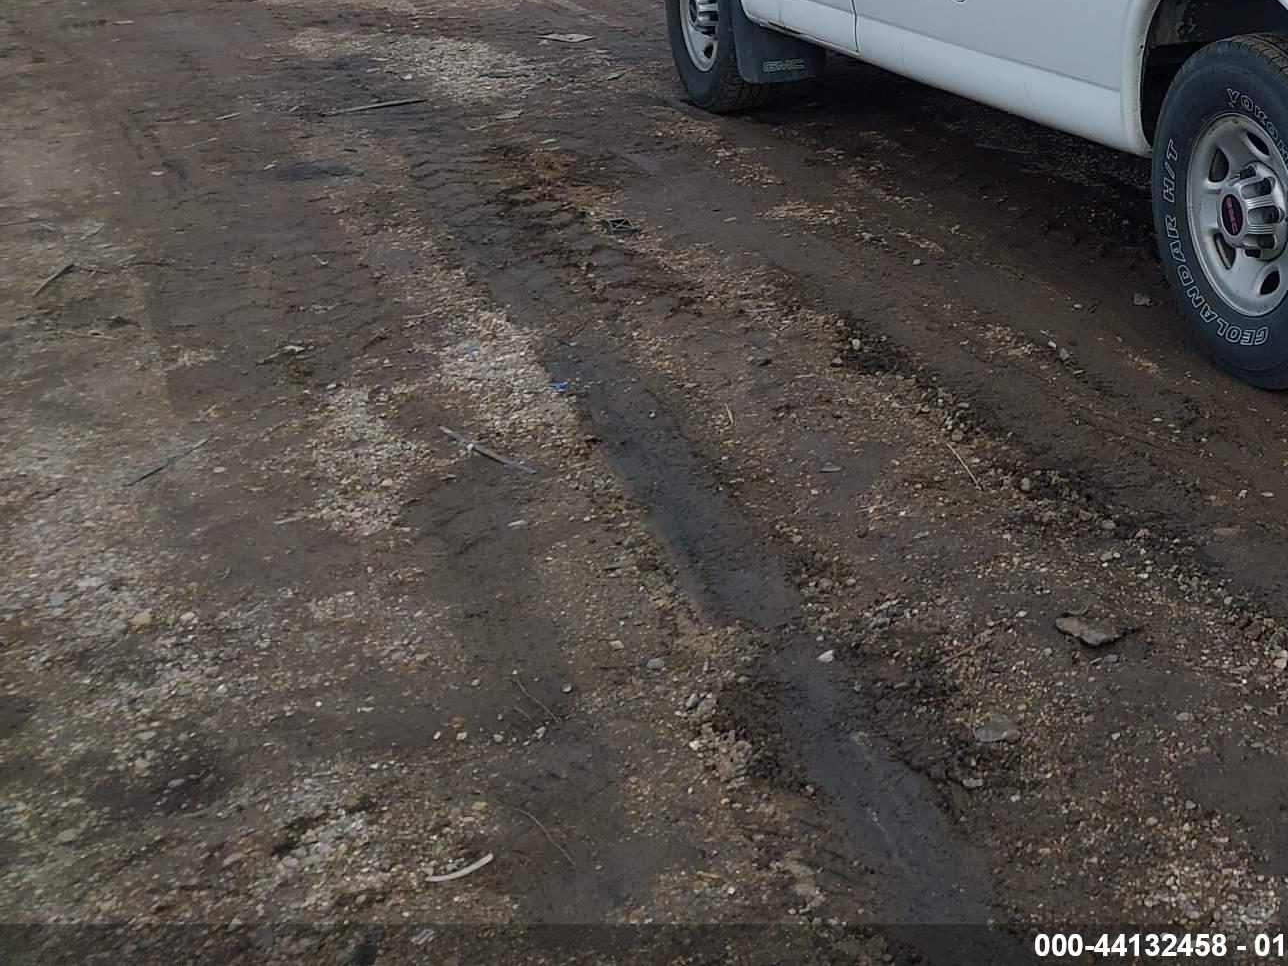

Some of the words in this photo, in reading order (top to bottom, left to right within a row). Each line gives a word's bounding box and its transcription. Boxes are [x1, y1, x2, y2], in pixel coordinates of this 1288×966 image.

[763, 59, 804, 72] GMC
[1163, 138, 1180, 203] H/T
[1165, 214, 1270, 346] GEOLANDAR
